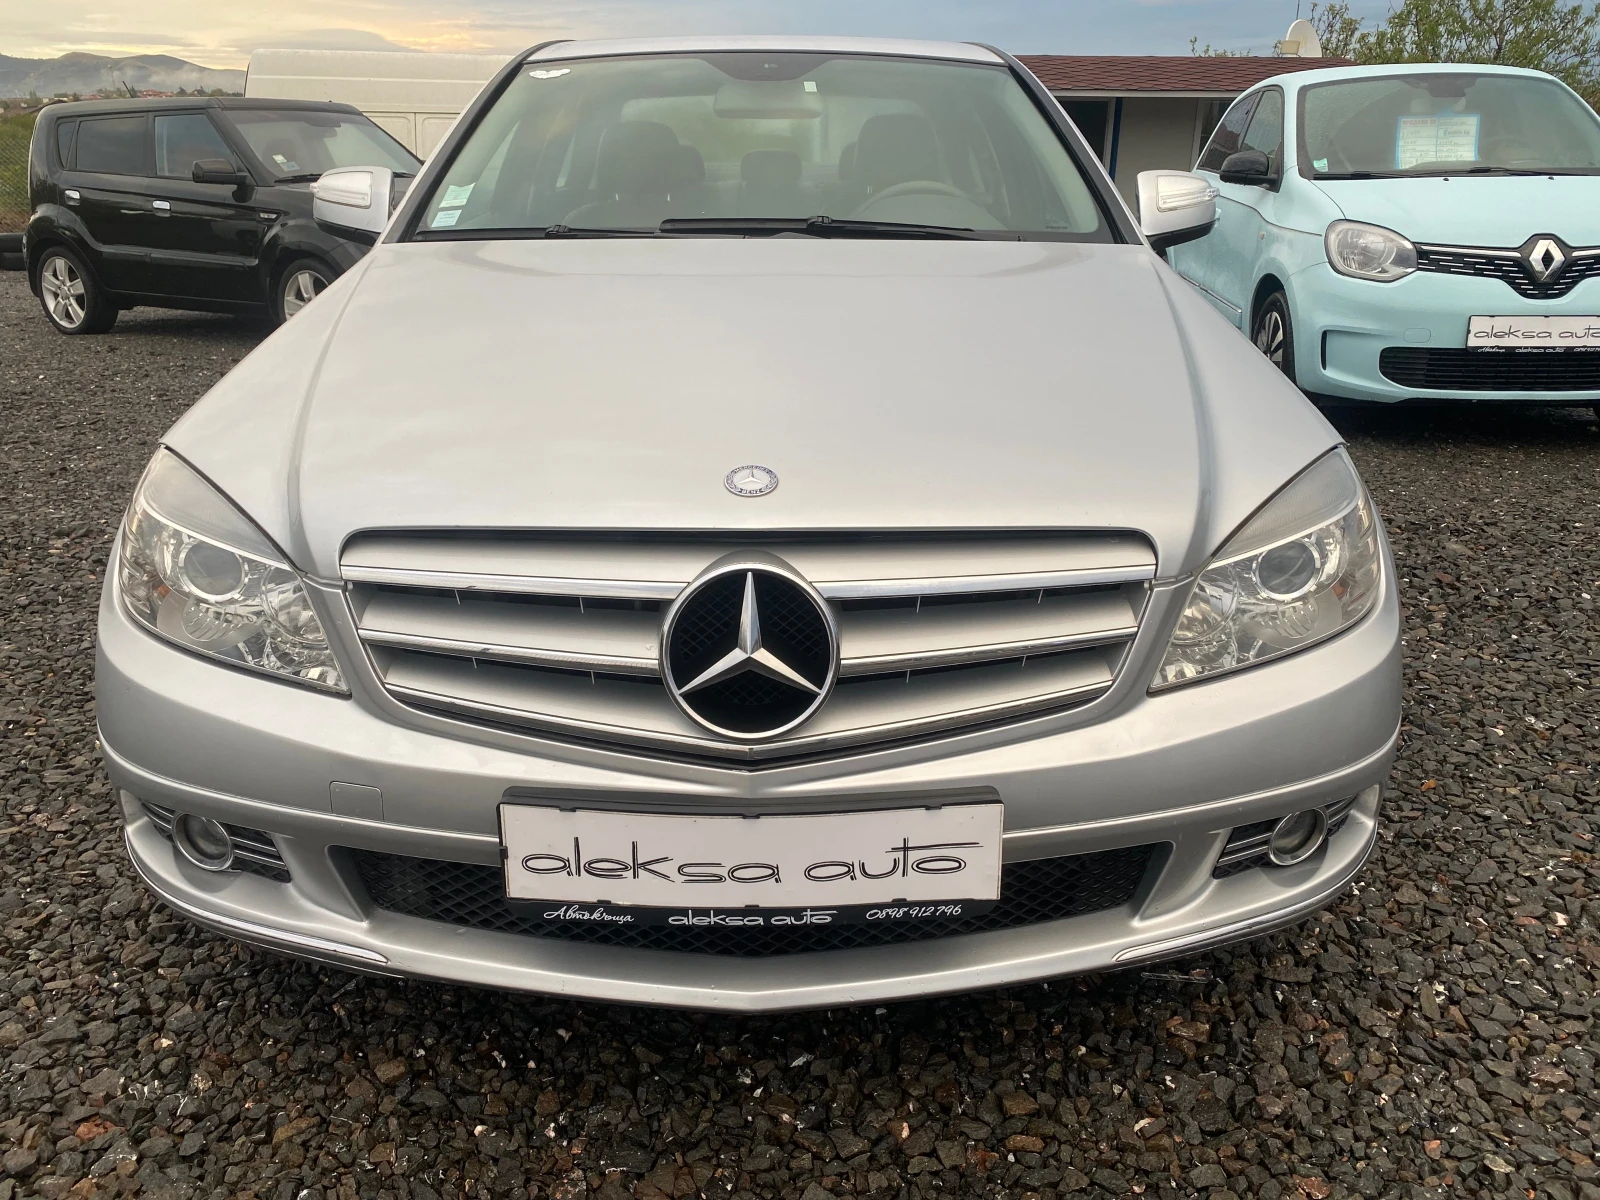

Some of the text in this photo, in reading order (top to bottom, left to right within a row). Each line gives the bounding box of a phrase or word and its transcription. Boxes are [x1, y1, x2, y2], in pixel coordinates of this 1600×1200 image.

[1474, 325, 1552, 339] aleksa
[521, 837, 984, 884] aleksa auto
[668, 908, 838, 926] aleksa auto
[865, 904, 962, 920] 0898 912 796
